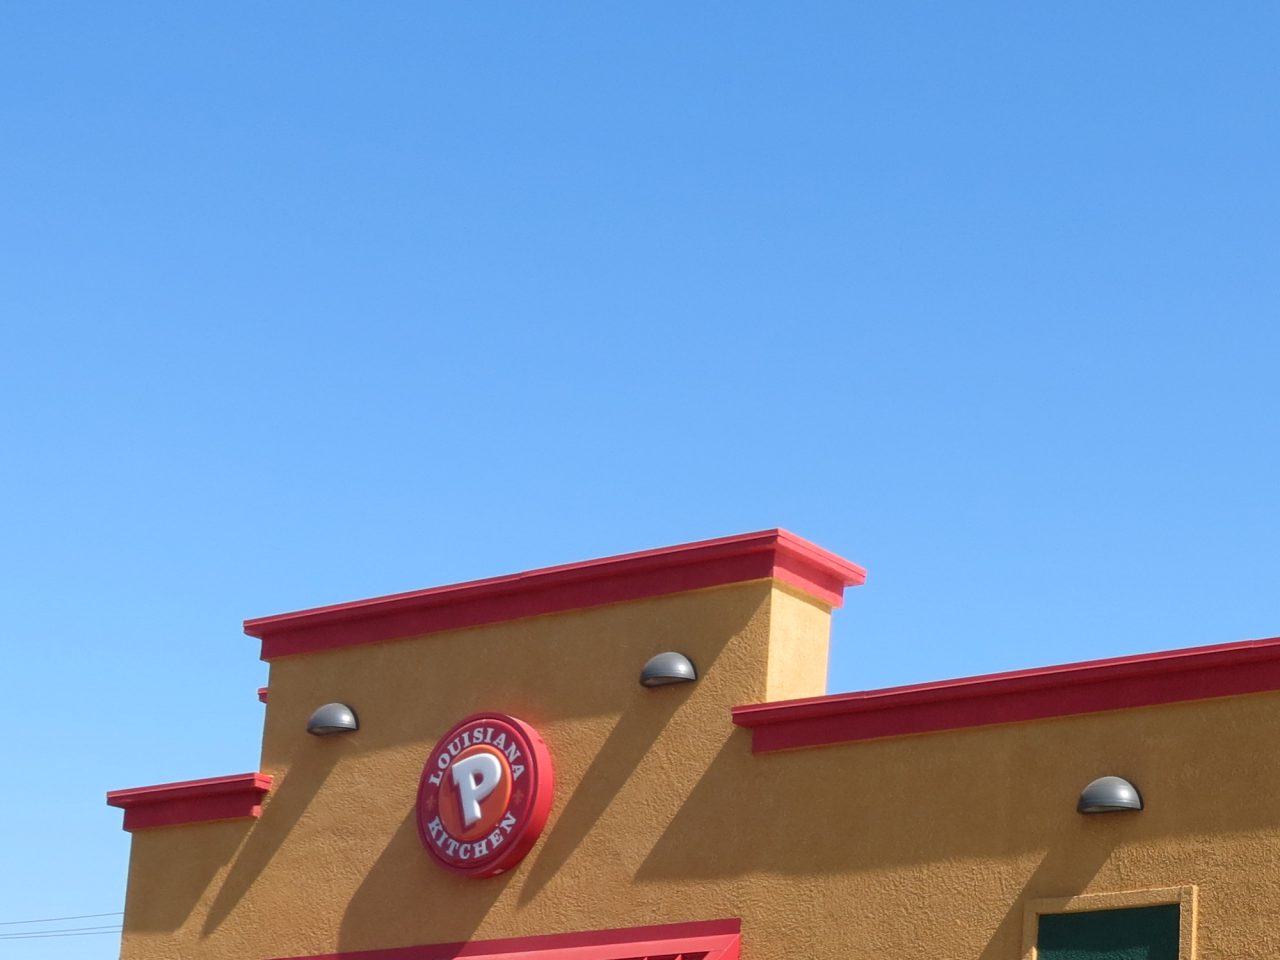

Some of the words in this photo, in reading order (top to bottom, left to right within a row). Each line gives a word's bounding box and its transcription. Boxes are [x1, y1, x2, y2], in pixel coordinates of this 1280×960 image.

[429, 728, 525, 787] LOUISIANA
[451, 753, 502, 827] P
[428, 811, 517, 859] KITCHEN
